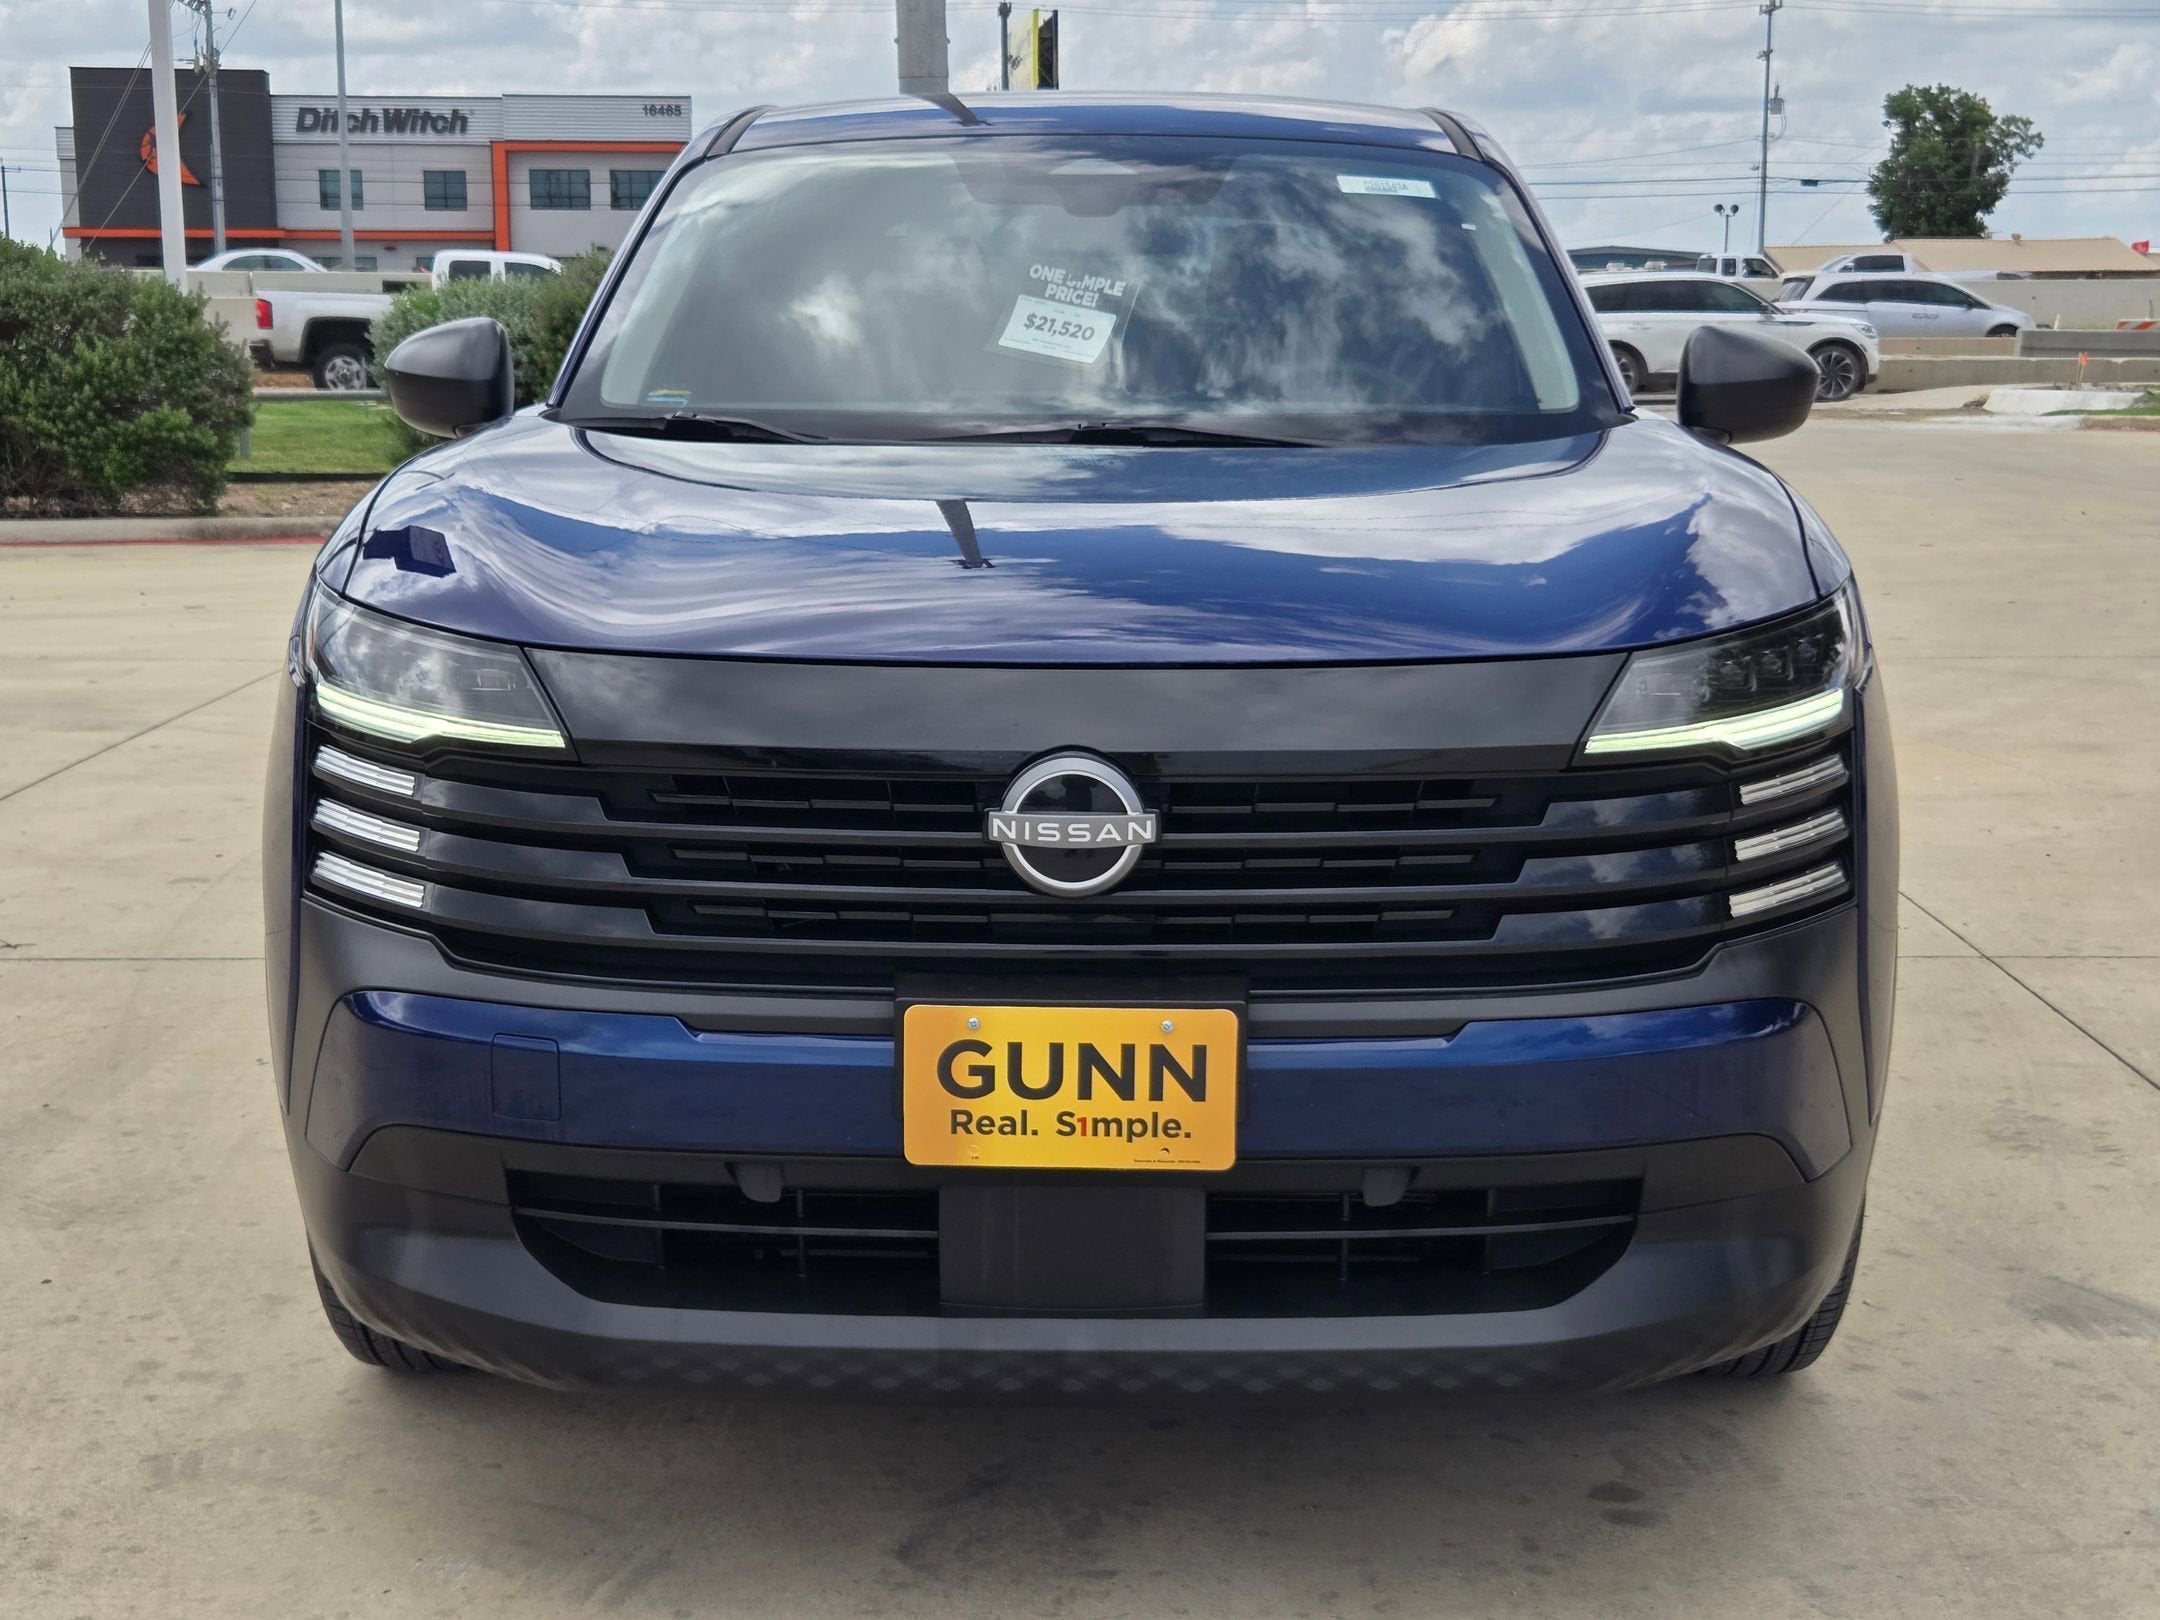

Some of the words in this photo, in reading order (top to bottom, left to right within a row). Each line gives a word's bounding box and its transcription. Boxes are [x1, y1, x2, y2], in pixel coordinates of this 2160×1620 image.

[296, 107, 379, 133] Ditch
[382, 108, 468, 134] Witch
[642, 103, 682, 118] 16465
[1029, 264, 1066, 284] ONE
[1044, 283, 1099, 308] PRICE!
[1024, 312, 1095, 341] $21,520
[992, 817, 1152, 843] NISSAN
[936, 1038, 1208, 1103] GUNN
[950, 1109, 1039, 1137] Real.
